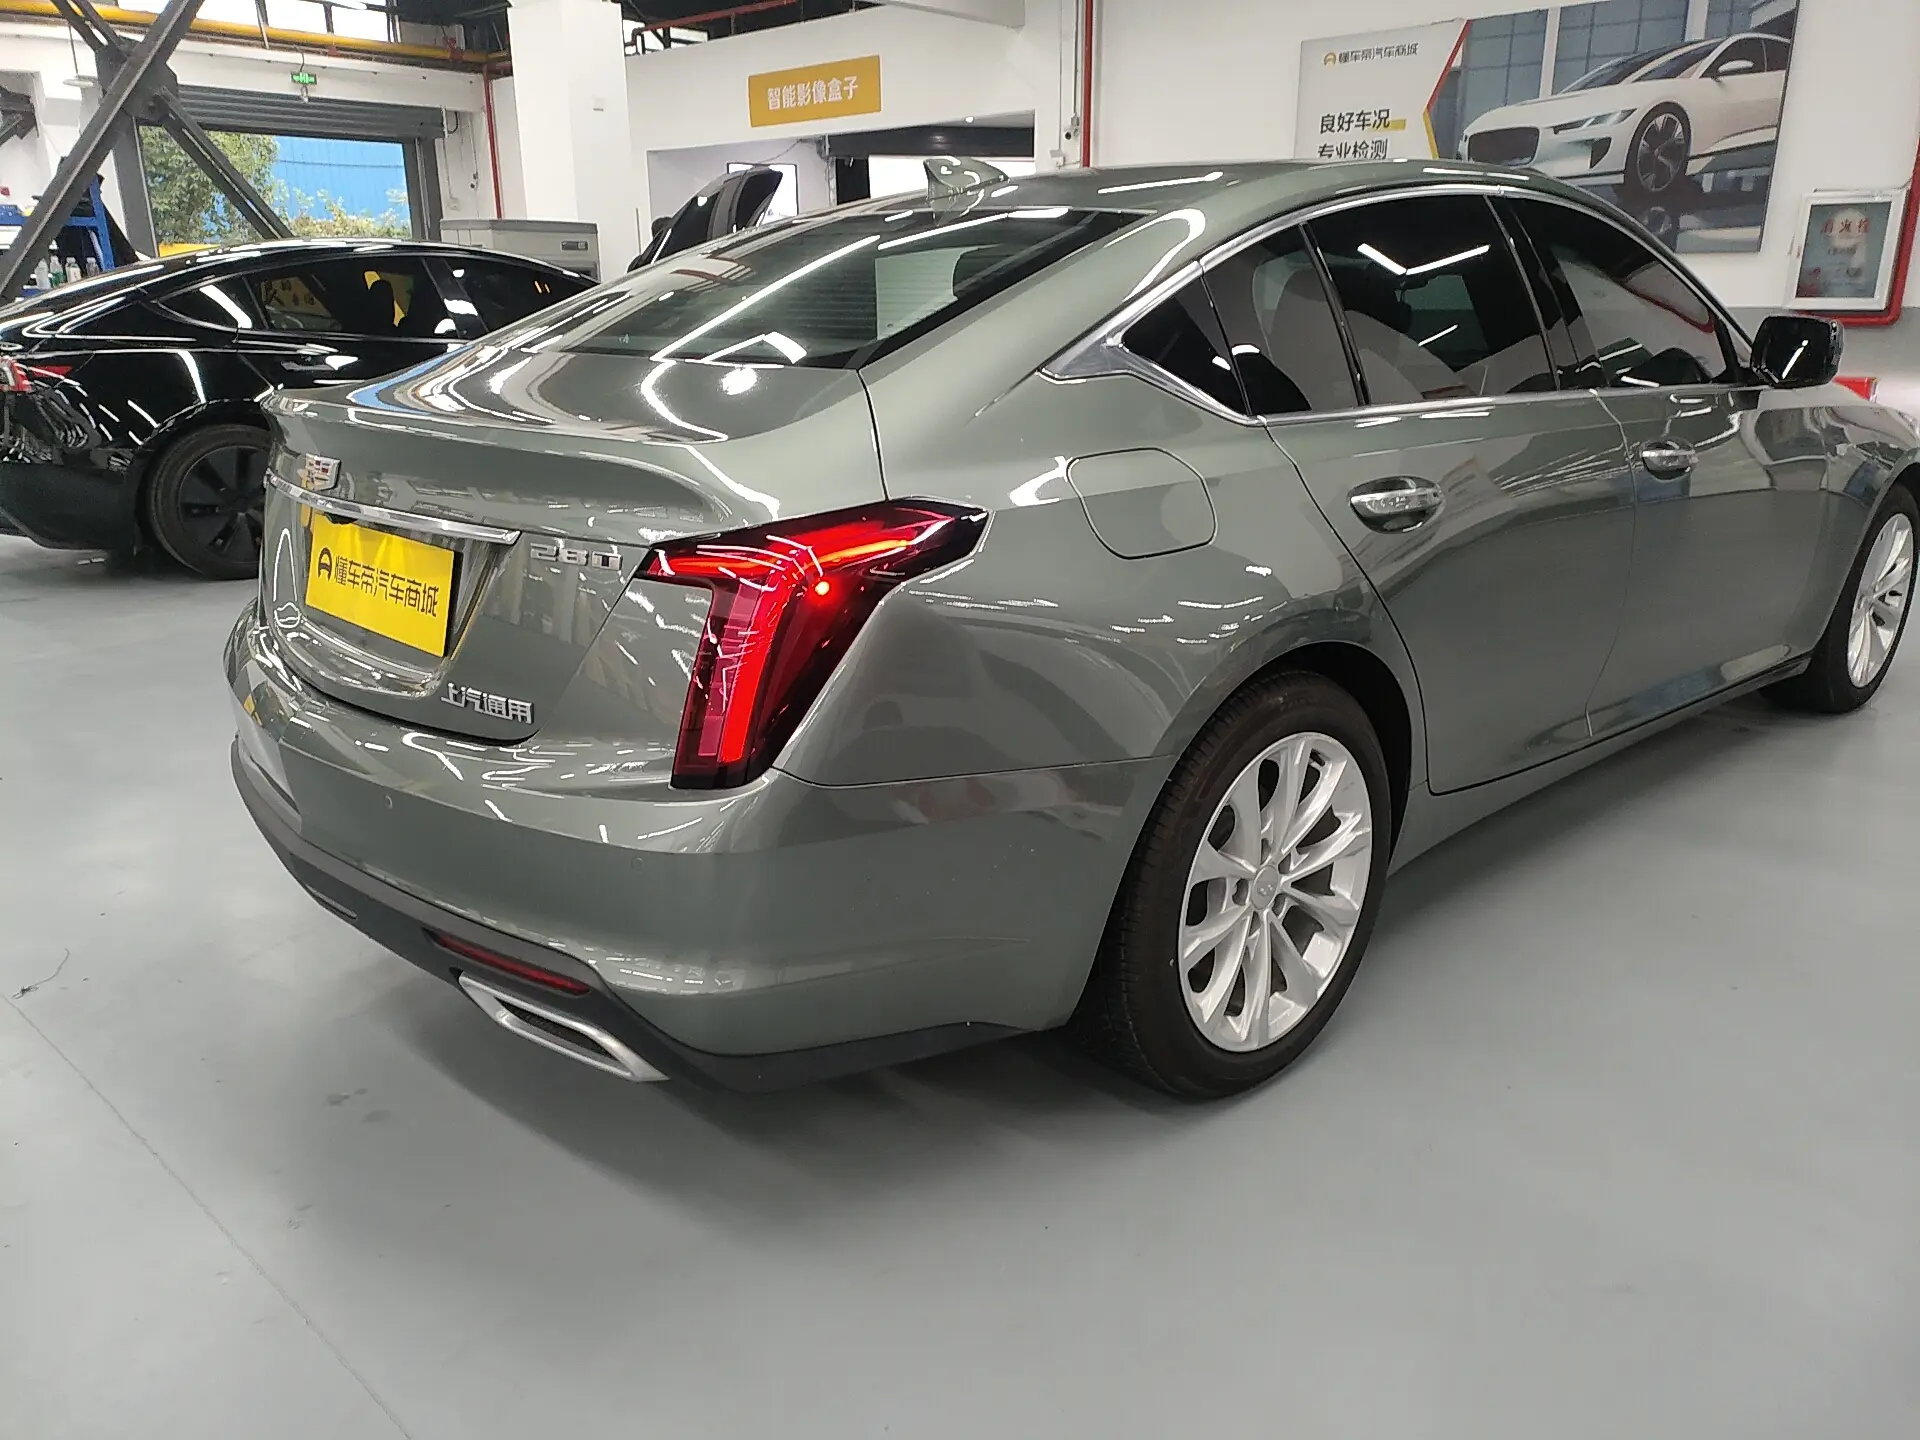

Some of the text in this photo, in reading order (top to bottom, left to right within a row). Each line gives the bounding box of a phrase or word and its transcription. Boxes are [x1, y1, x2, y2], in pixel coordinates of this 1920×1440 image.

[767, 75, 858, 111] 智能影像盒子
[1320, 109, 1390, 134] 良好车况
[1318, 139, 1388, 160] 专业检测
[334, 554, 439, 617] 懂车帝汽车商城
[440, 682, 533, 724] 上汽通用
